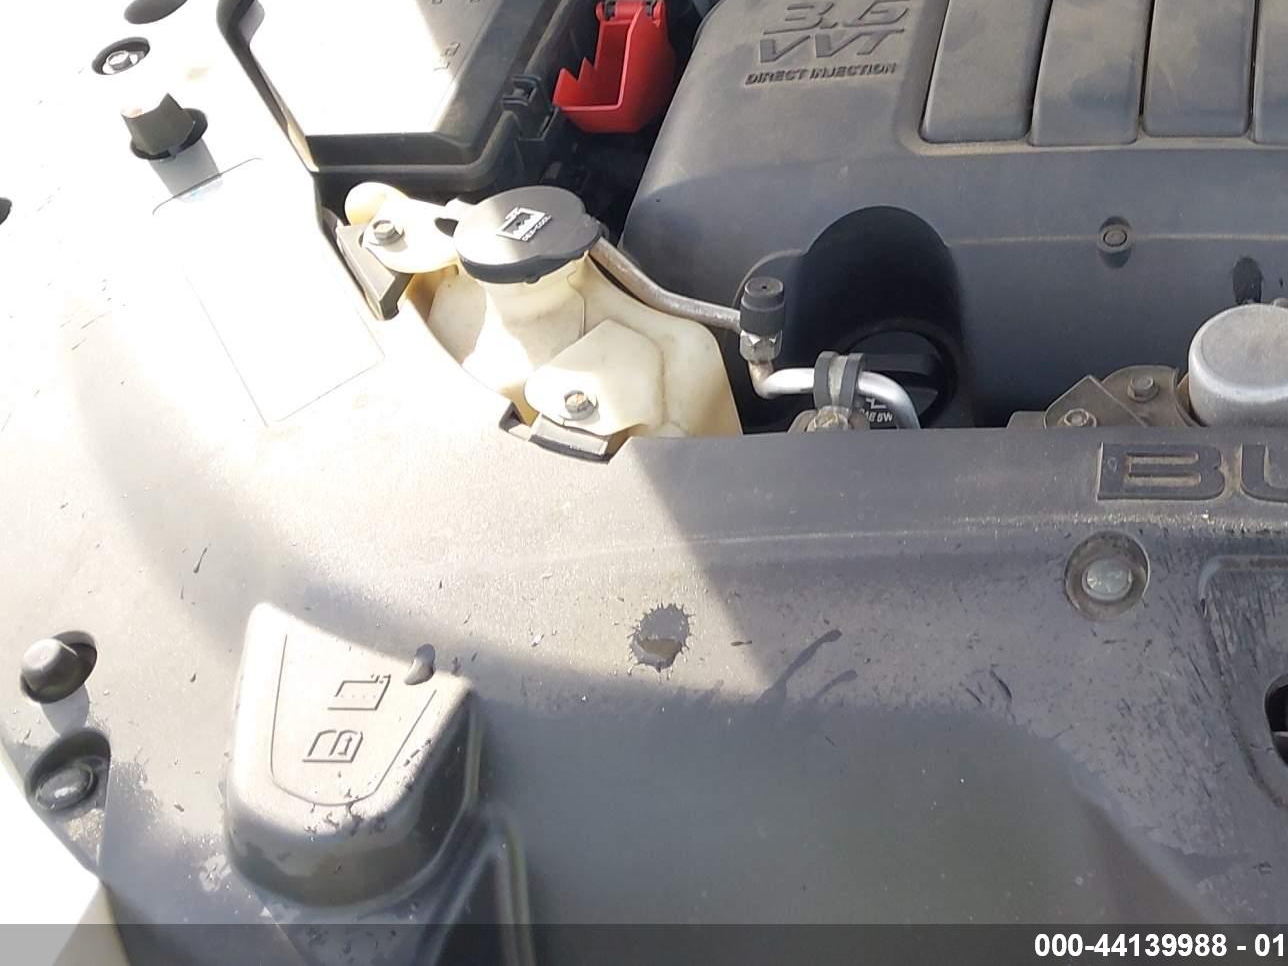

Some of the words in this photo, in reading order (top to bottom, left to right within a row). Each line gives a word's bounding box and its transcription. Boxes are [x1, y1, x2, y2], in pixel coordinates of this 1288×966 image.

[759, 28, 905, 63] VVT
[745, 68, 808, 86] DIRECT
[809, 62, 898, 80] INJECTION
